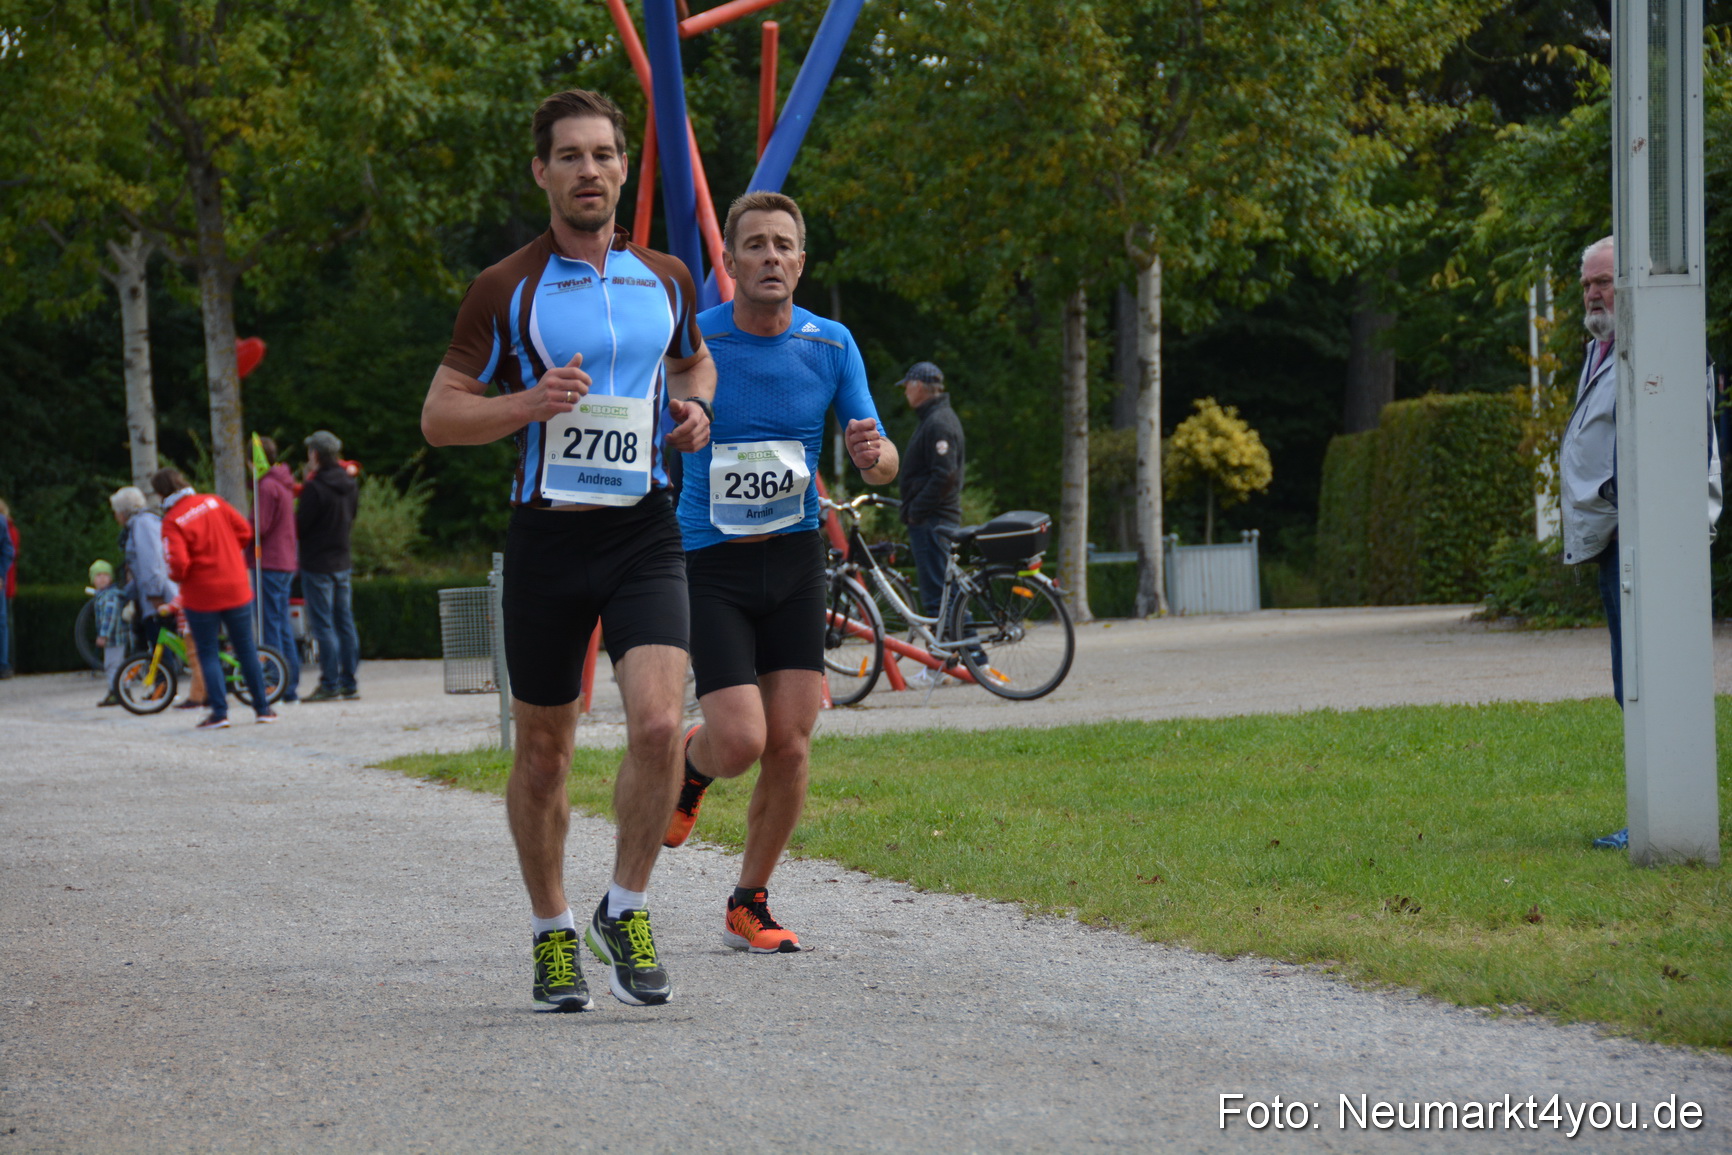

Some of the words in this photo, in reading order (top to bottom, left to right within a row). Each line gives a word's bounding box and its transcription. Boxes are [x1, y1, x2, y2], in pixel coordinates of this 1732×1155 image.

[636, 278, 657, 288] RACER
[591, 404, 629, 417] BOCK
[562, 427, 638, 464] 2708
[577, 472, 622, 487] Andreas
[724, 469, 794, 499] 2364
[746, 507, 774, 519] Armin
